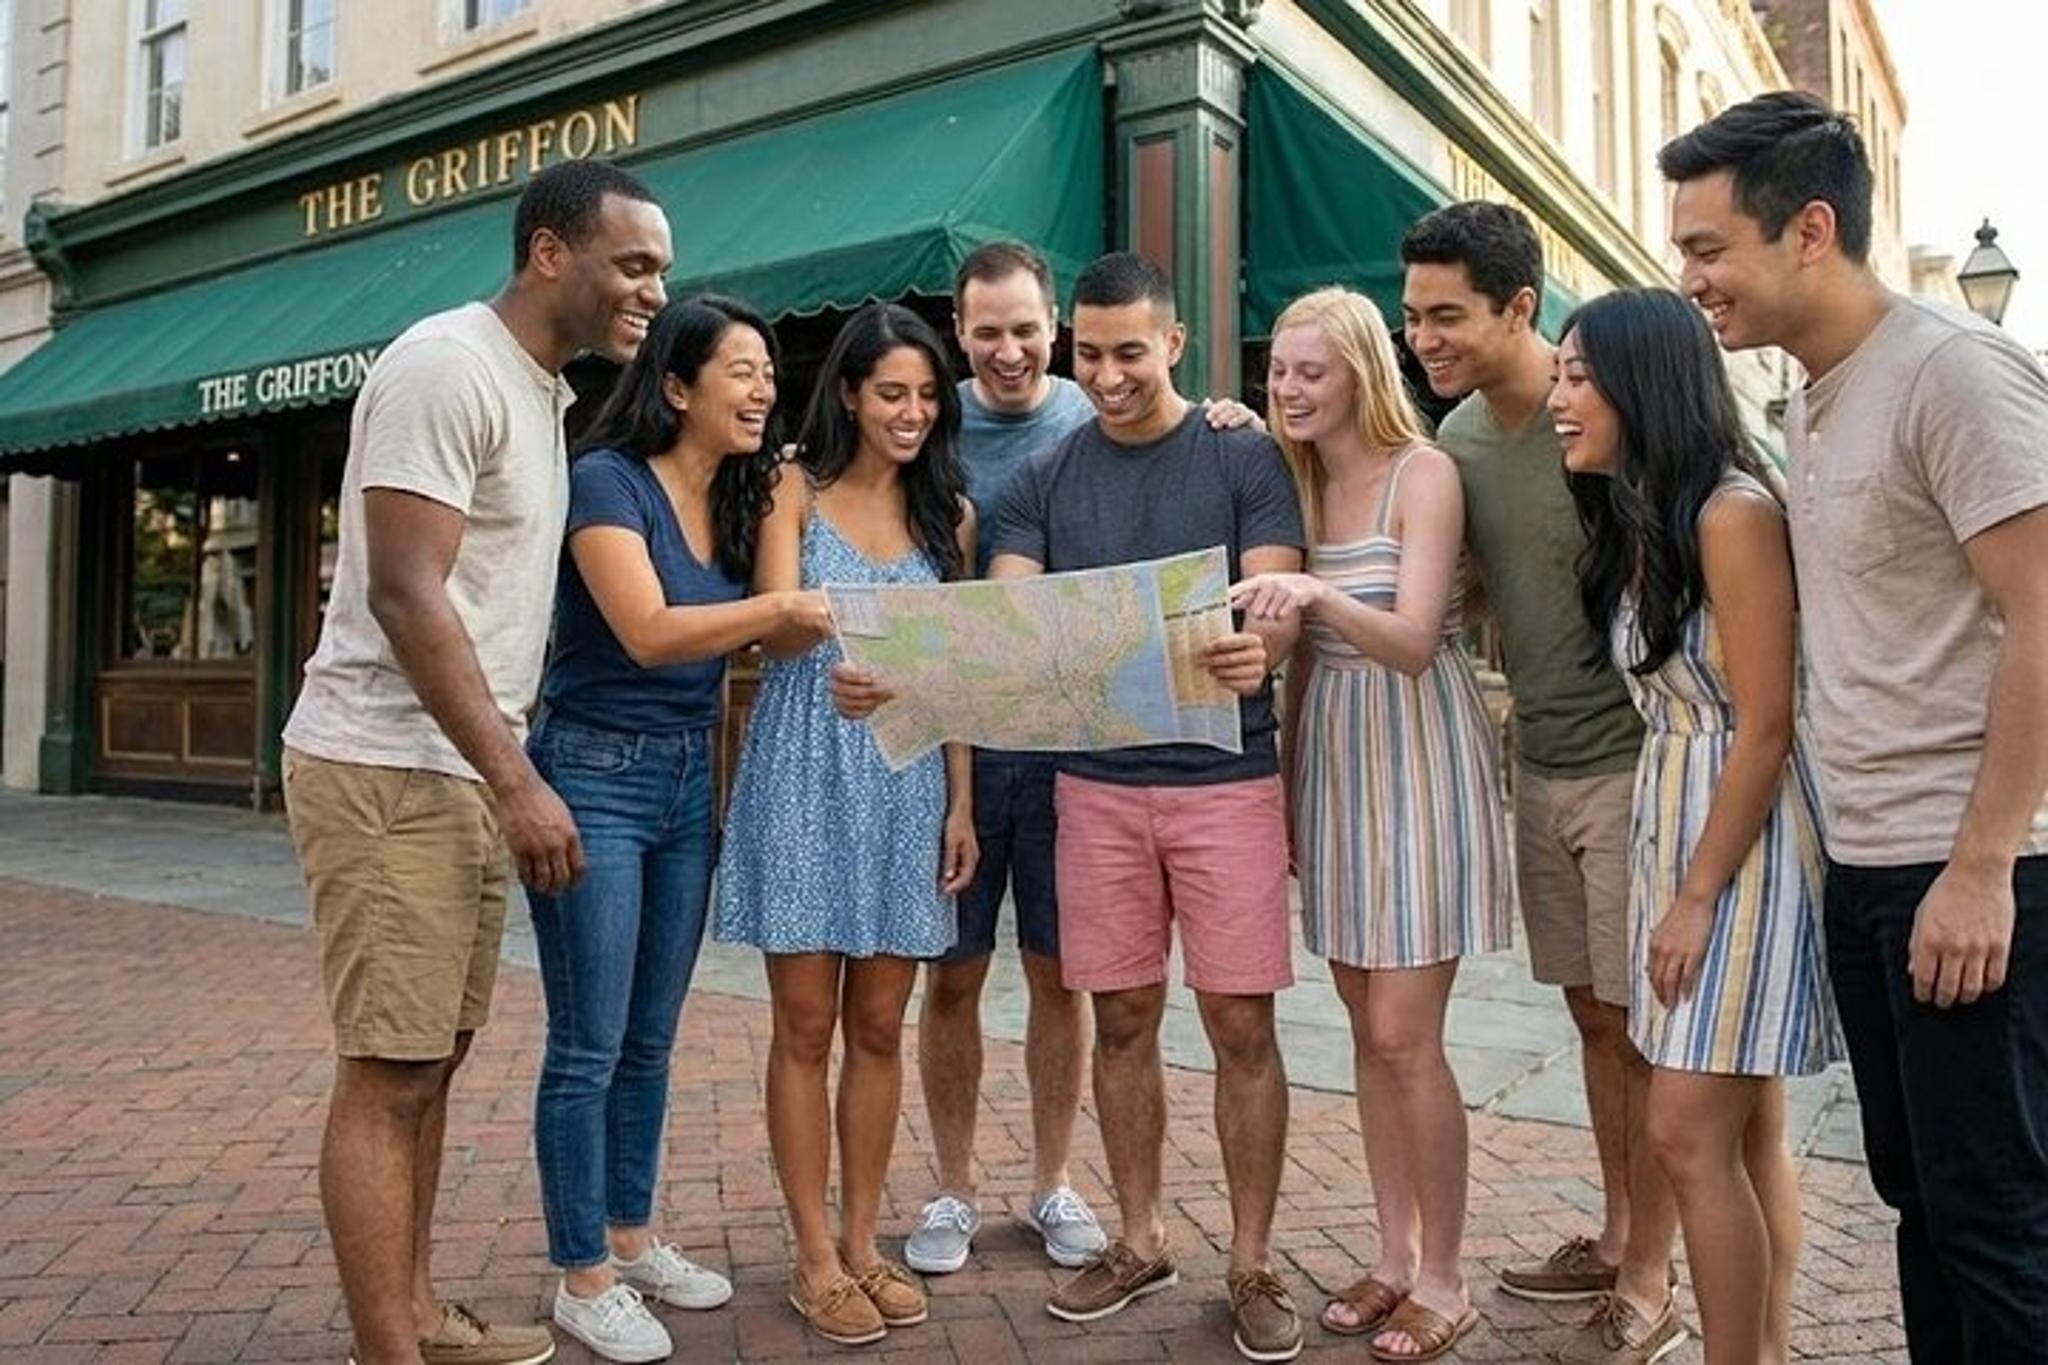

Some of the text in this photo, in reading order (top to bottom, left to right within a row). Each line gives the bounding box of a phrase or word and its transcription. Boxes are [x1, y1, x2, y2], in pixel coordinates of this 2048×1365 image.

[300, 94, 638, 237] THE GRIFFON
[199, 349, 377, 413] THE GRIFFON
